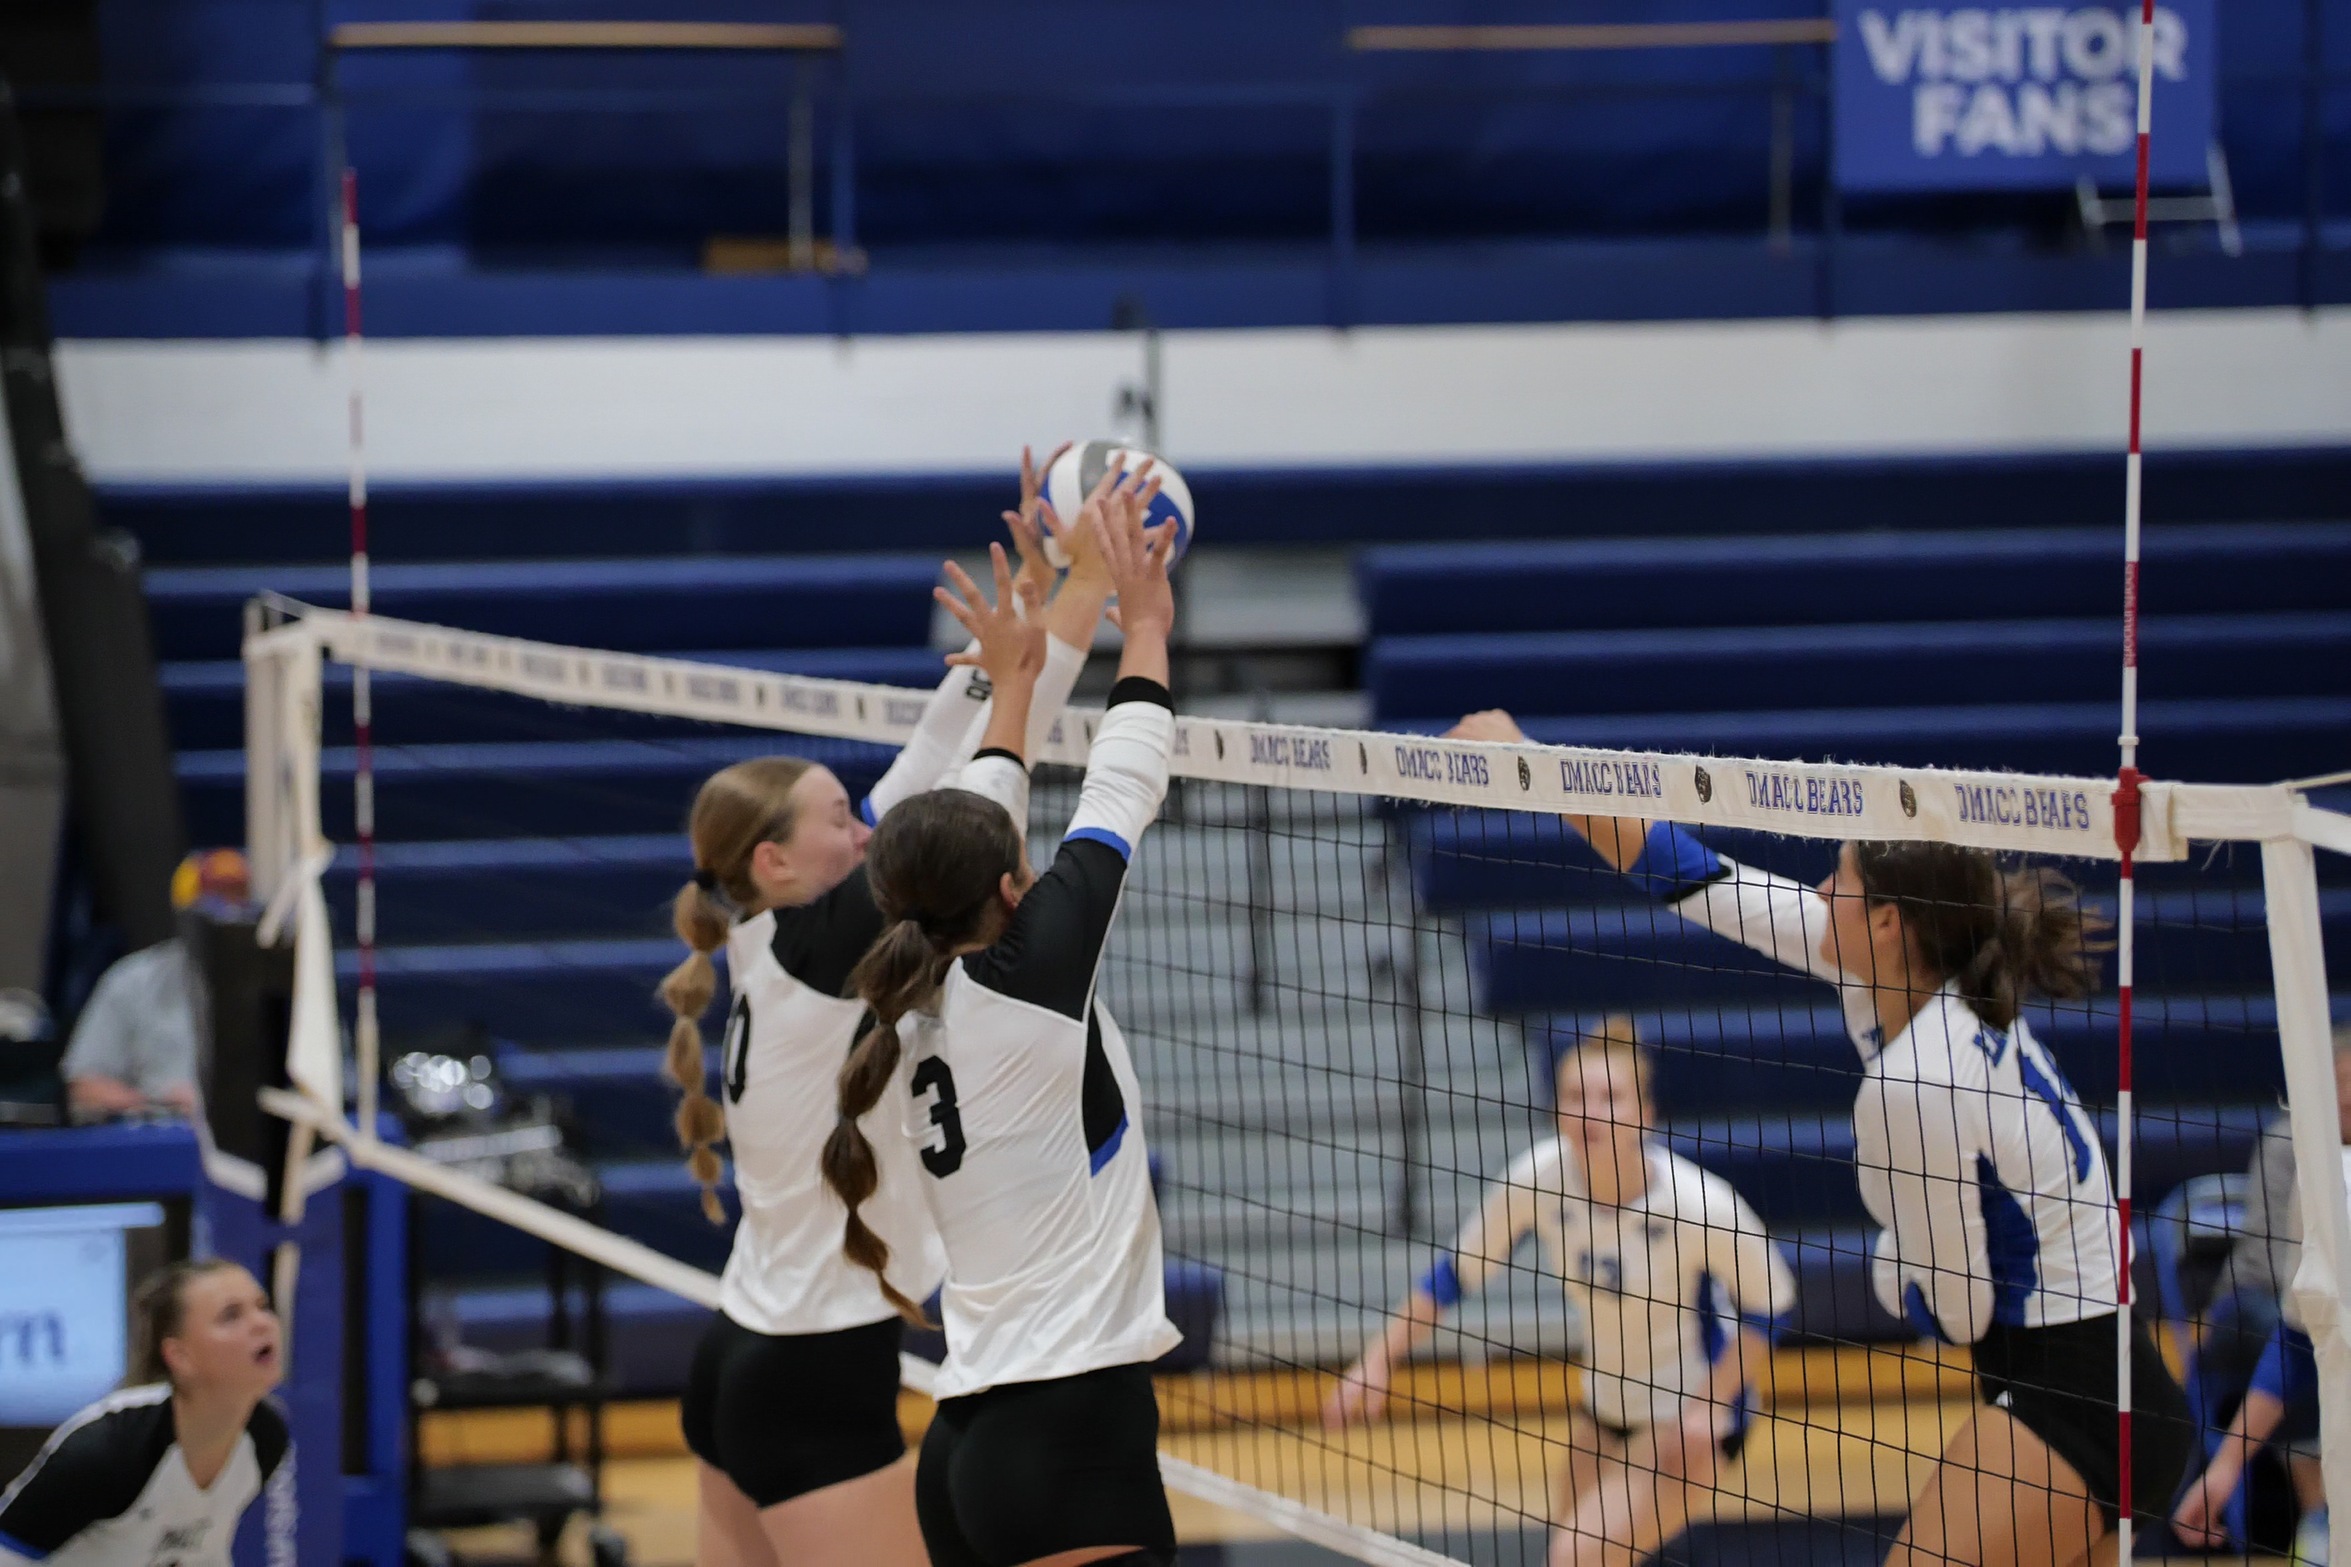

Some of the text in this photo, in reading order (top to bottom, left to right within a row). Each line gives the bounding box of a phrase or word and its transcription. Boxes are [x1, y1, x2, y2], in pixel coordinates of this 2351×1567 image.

[1859, 8, 2187, 83] VISITOR
[1912, 83, 2136, 155] FANS
[1560, 760, 1613, 794] DMACC
[1805, 775, 1864, 816] BEARS
[911, 1055, 966, 1178] 3
